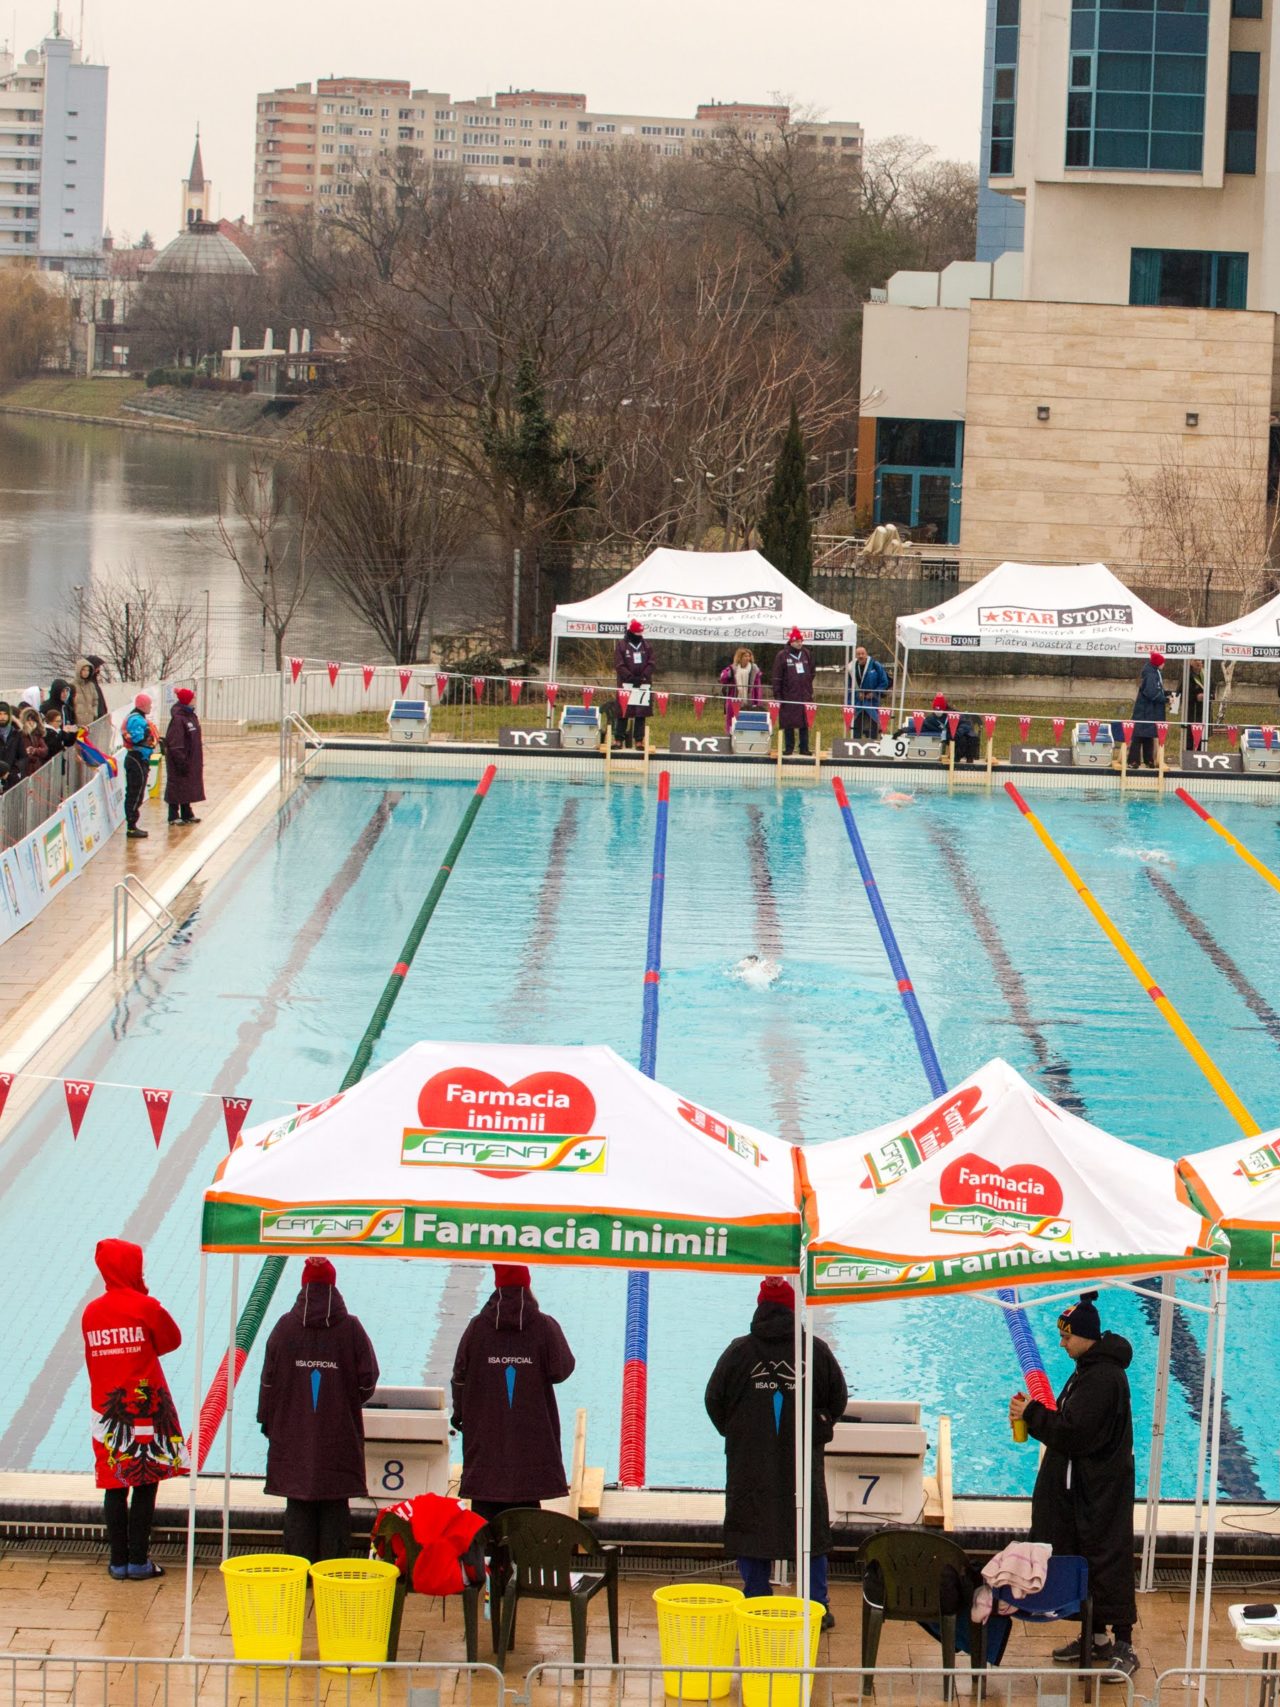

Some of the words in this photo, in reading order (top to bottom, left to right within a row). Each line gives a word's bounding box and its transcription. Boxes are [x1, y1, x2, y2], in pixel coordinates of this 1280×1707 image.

[652, 596, 704, 610] STAR
[712, 596, 776, 611] STONE
[1002, 610, 1055, 624] STAR
[1062, 609, 1126, 624] STONE
[576, 623, 597, 632] STAR
[599, 624, 626, 633] STONE
[723, 628, 730, 636] e
[734, 628, 768, 637] Beton!
[816, 630, 842, 640] STONE
[930, 635, 950, 644] STAR
[952, 636, 979, 646] STONE
[994, 637, 1028, 647] Piatra
[1076, 642, 1082, 650] e
[1086, 642, 1120, 650] Beton!
[1144, 644, 1165, 652] STAR
[1167, 644, 1194, 654] STONE
[1230, 646, 1252, 656] STAR
[1254, 647, 1280, 656] STONE
[638, 688, 646, 705] 7
[510, 730, 548, 744] TYR
[681, 736, 718, 751] TYR
[844, 742, 880, 756] TYR
[894, 742, 905, 757] 9
[918, 748, 926, 757] 6
[1022, 748, 1060, 763] TYR
[1089, 755, 1098, 763] 5
[1194, 754, 1230, 768] TYR
[1258, 760, 1266, 768] 4
[66, 1082, 90, 1096] TYR
[145, 1090, 168, 1102] TYR
[447, 1084, 570, 1108] Farmacia
[224, 1098, 248, 1111] TYR
[468, 1110, 545, 1132] inimii
[422, 1140, 548, 1160] CATENA
[959, 1167, 1044, 1195] Farmacia
[975, 1189, 1028, 1212] inimii
[944, 1214, 1030, 1231] CATENA
[276, 1219, 363, 1232] CATENA
[414, 1213, 600, 1250] Farmacia
[611, 1221, 728, 1256] inimii
[126, 1346, 142, 1354] TEAM
[307, 1360, 338, 1369] OFFICIAL
[502, 1356, 532, 1364] OFFICIAL
[382, 1460, 404, 1491] 8
[858, 1474, 880, 1505] 7
